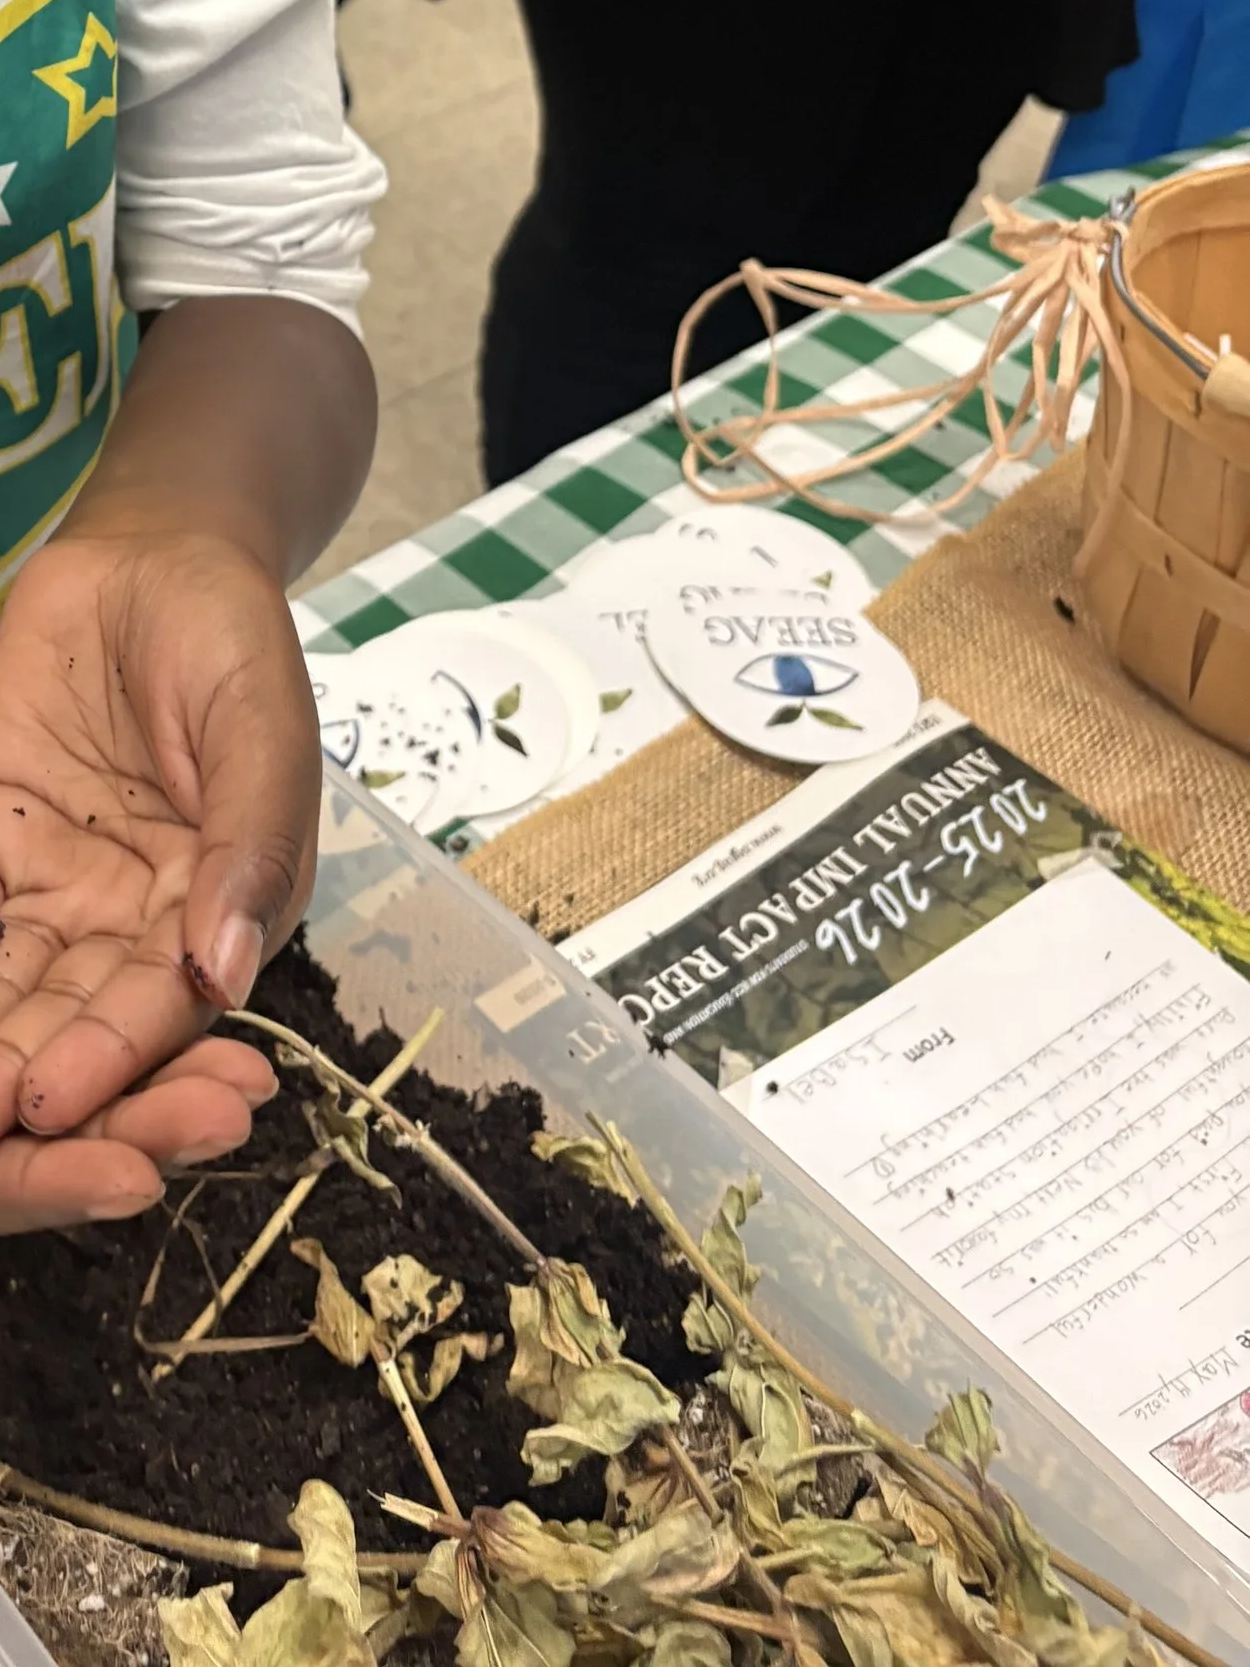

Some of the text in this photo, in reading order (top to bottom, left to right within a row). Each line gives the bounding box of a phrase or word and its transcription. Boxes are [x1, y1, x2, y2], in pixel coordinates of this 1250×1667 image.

[703, 614, 859, 649] SEEAG
[852, 747, 1000, 853] ANNUAL
[718, 846, 863, 961] IMPACT
[902, 1026, 956, 1063] From
[1177, 1220, 1217, 1256] for
[1187, 1344, 1239, 1385] May
